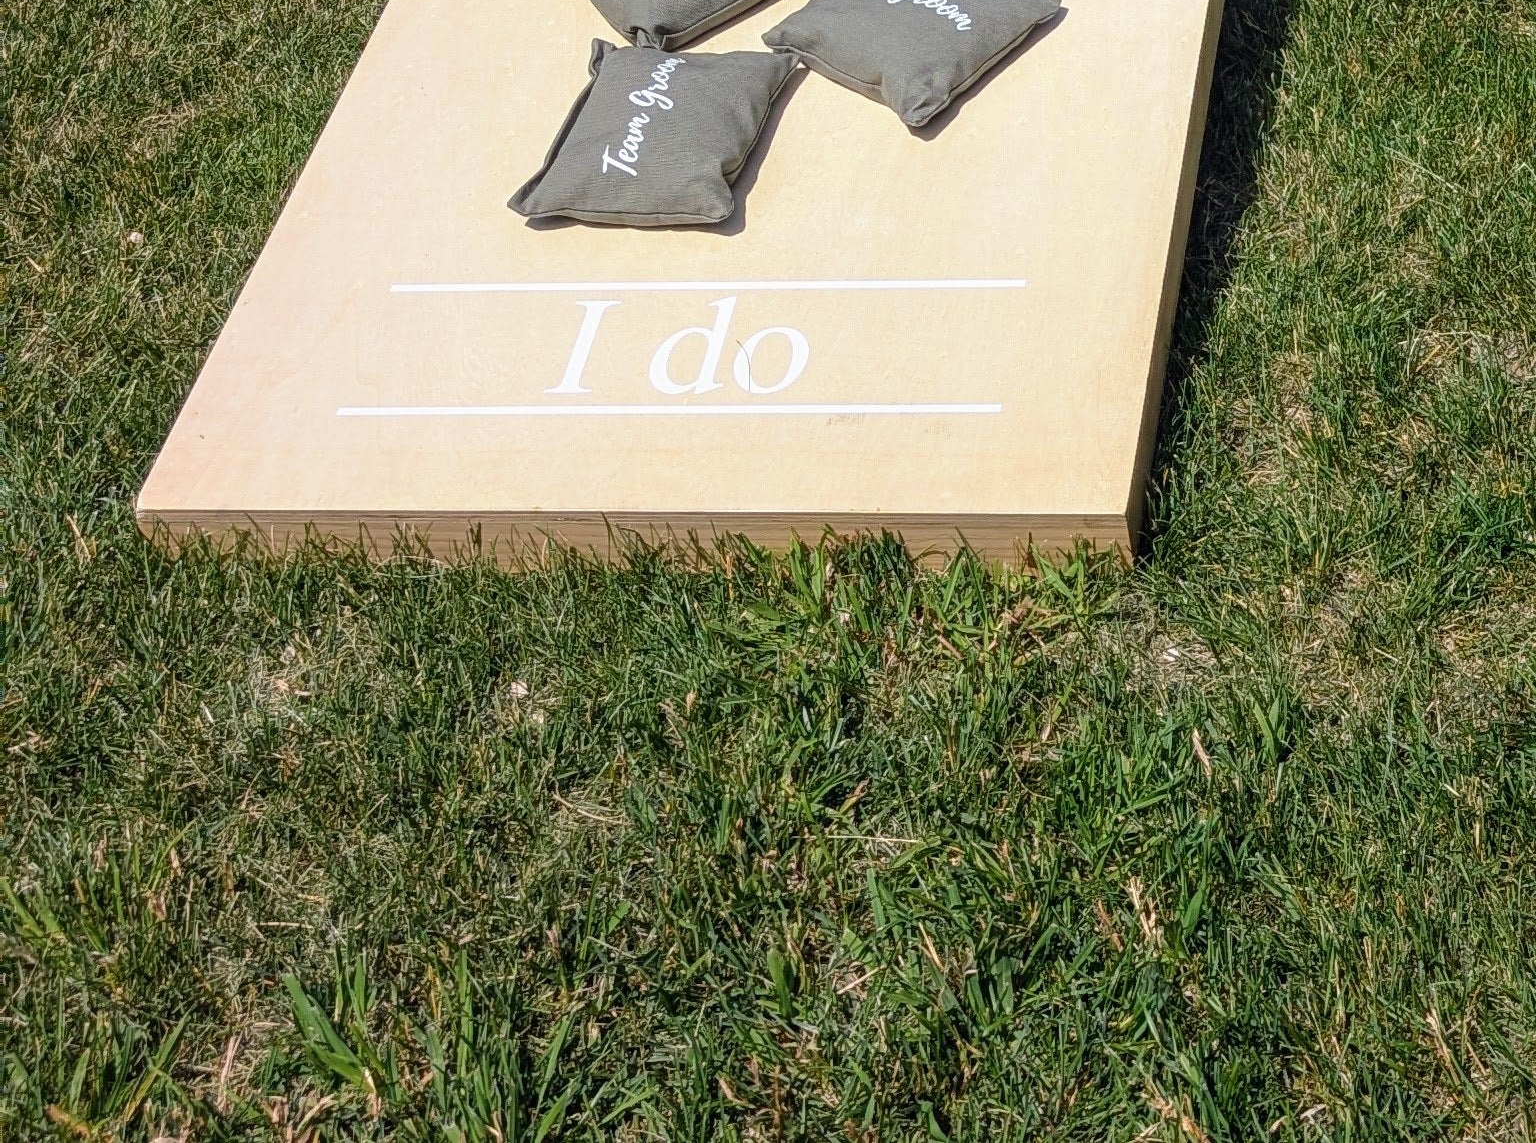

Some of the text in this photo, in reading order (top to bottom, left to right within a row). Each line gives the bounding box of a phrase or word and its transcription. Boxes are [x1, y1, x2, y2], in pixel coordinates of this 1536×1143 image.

[601, 112, 651, 177] Team
[543, 295, 811, 395] I do
